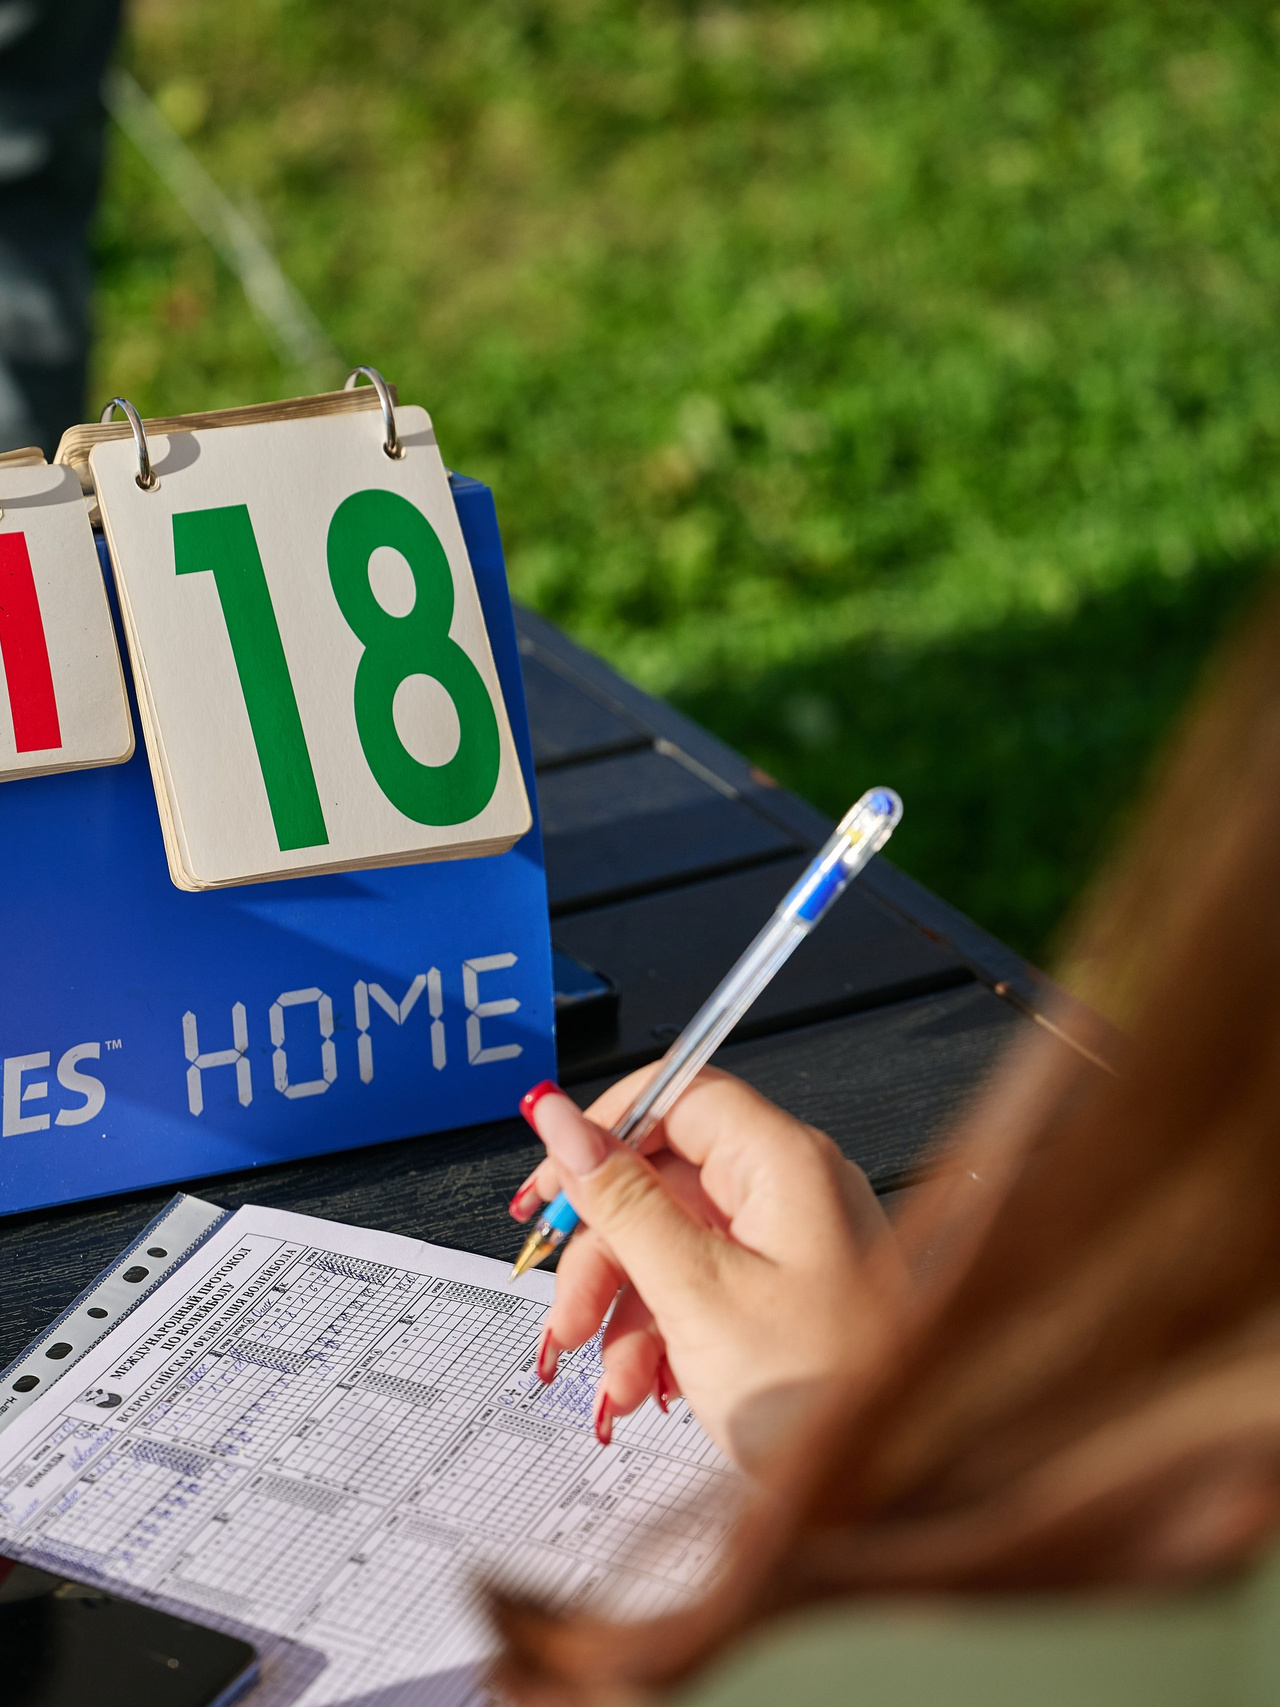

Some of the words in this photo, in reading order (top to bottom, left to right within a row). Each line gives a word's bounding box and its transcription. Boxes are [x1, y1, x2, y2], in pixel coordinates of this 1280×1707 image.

[172, 488, 501, 853] 18
[182, 953, 524, 1116] HOME
[110, 1292, 203, 1380] МЕЖДУНАРОДНЫЙ
[201, 1247, 252, 1299] ПРОТОКОЛ
[117, 1348, 197, 1423] ВСЕРОССИЙСКАЯ
[194, 1300, 246, 1349] ФЕДЕРАЦИЯ
[243, 1248, 297, 1300] ВОЛЕЙБОЛА
[161, 1334, 181, 1351] ПО
[180, 1282, 235, 1337] ВОЛЕЙБОЛУ
